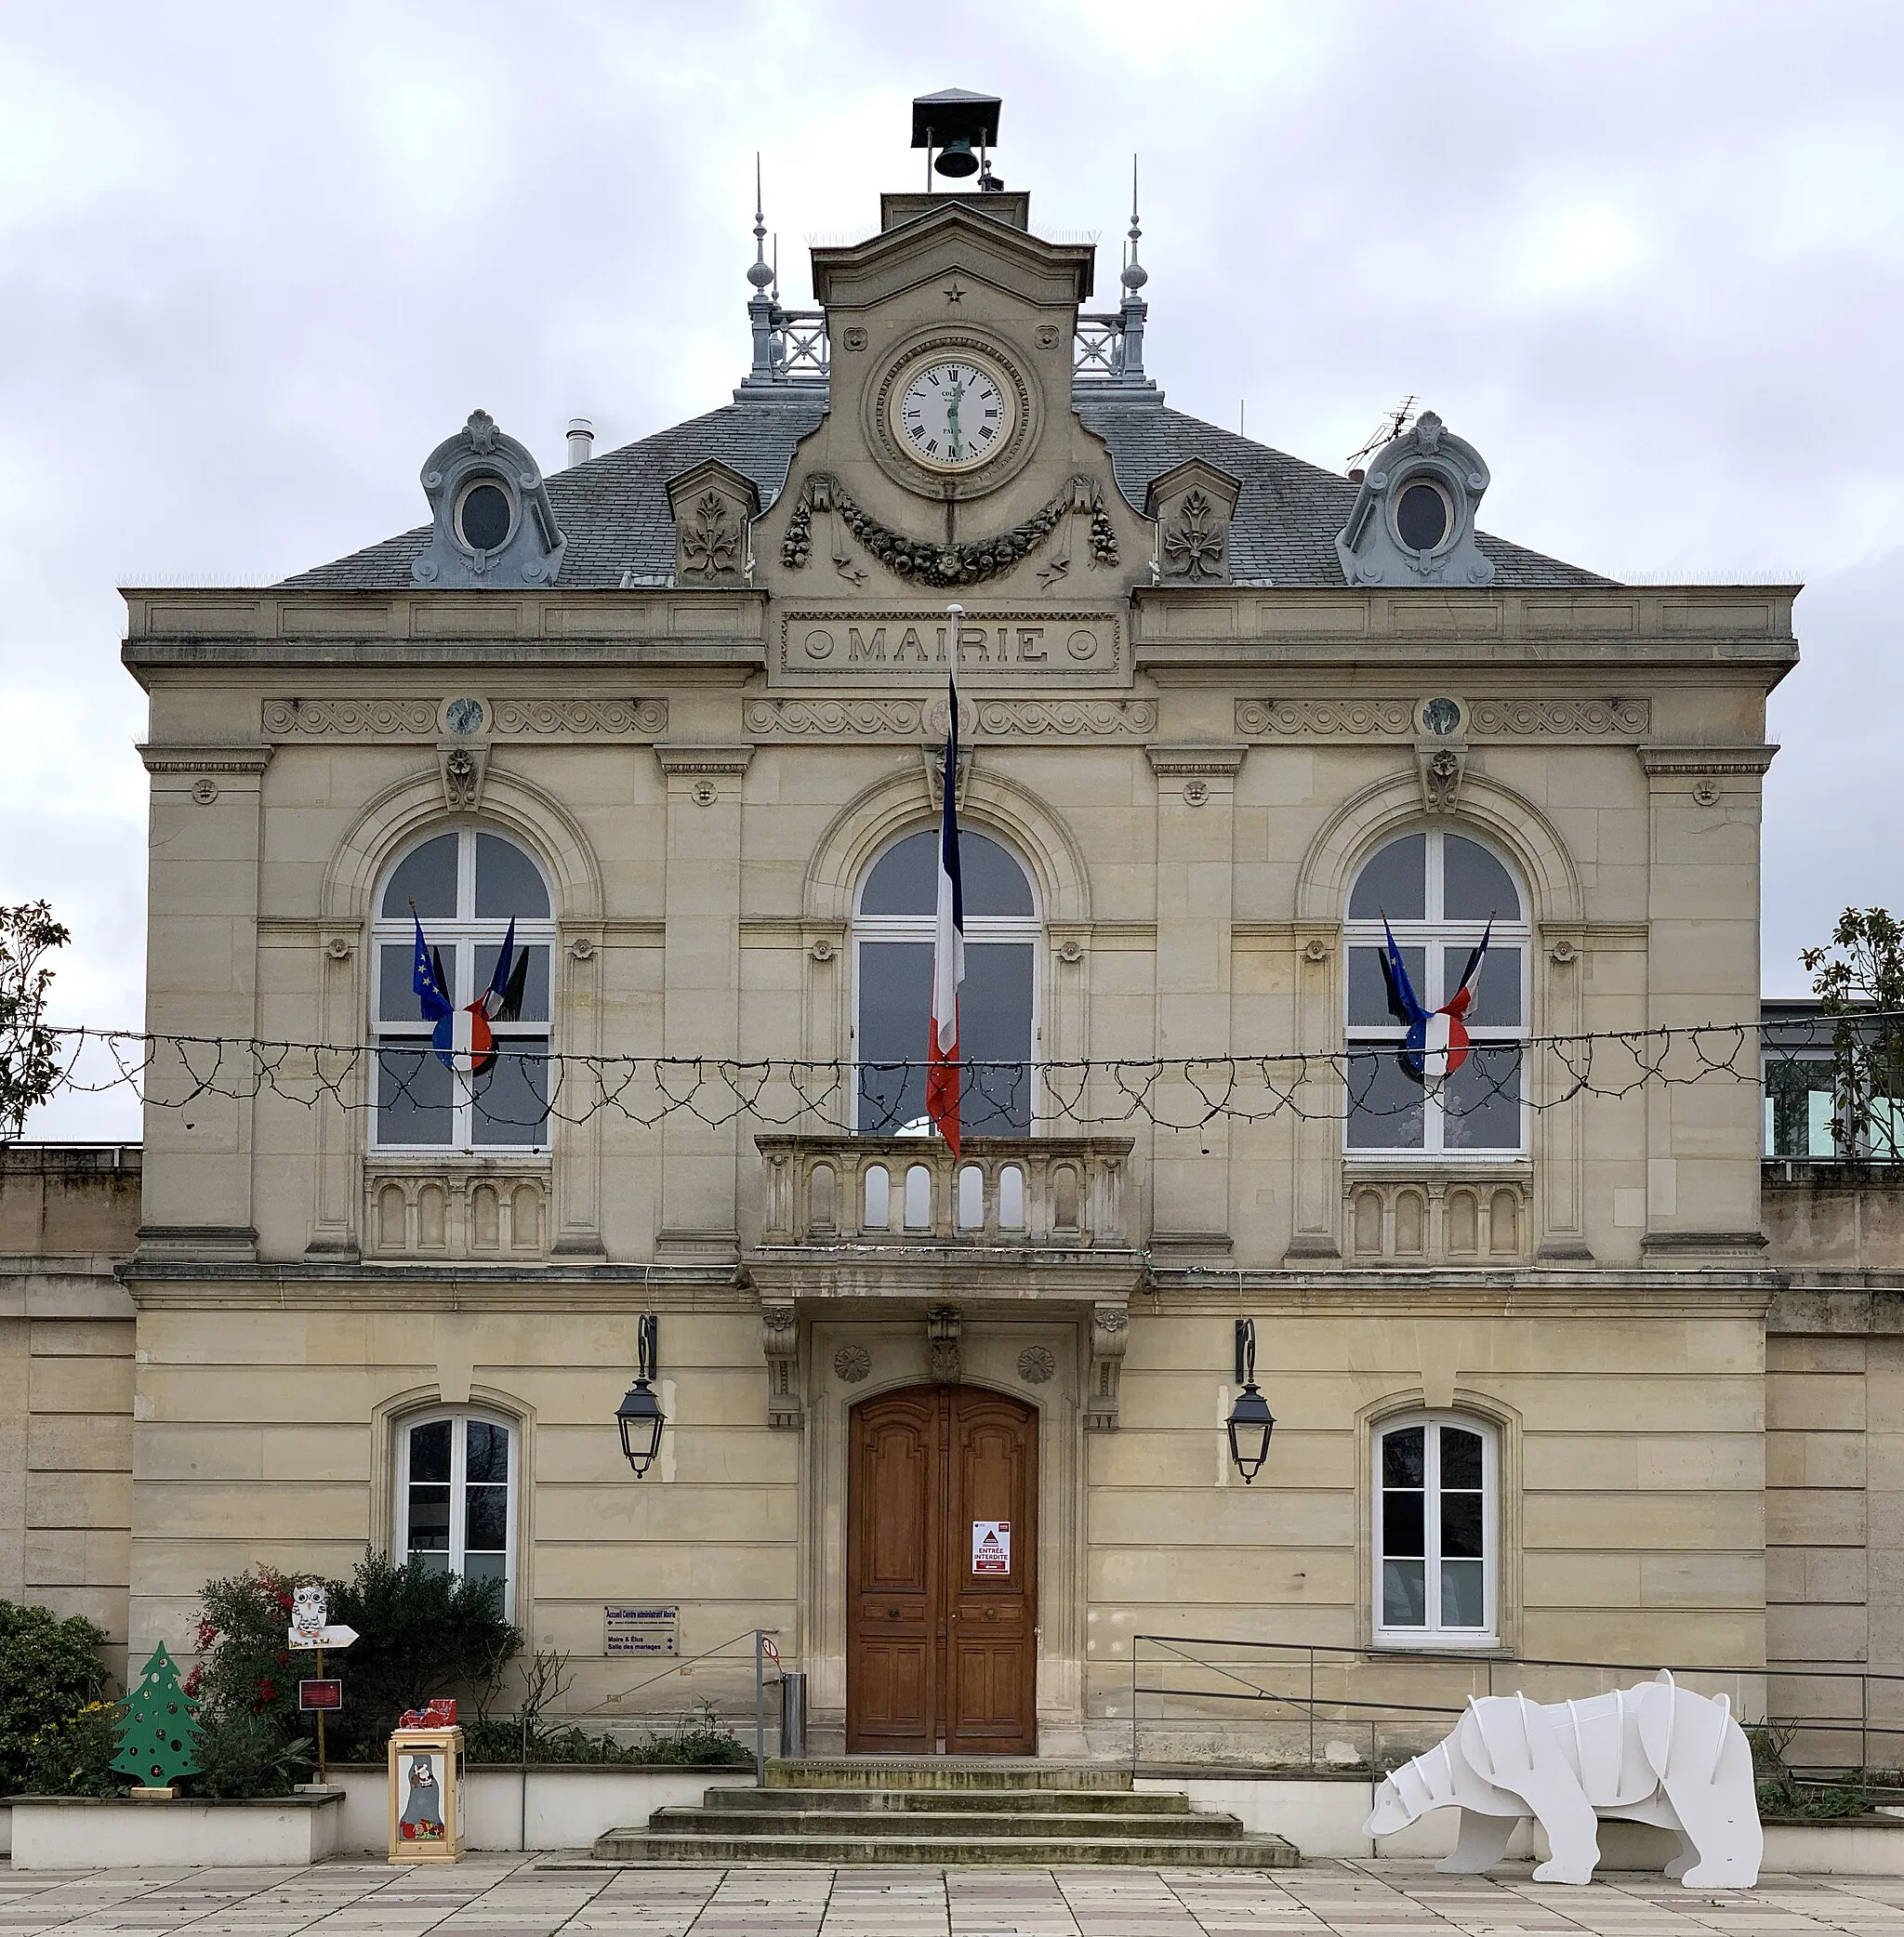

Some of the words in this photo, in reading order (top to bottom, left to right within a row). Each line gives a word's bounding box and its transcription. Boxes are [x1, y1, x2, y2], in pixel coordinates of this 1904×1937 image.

[848, 627, 1048, 662] MAIRIE
[606, 1610, 622, 1618] Accueil
[623, 1610, 637, 1618] Centre
[637, 1610, 662, 1618] administratif
[663, 1610, 676, 1618] Mairie
